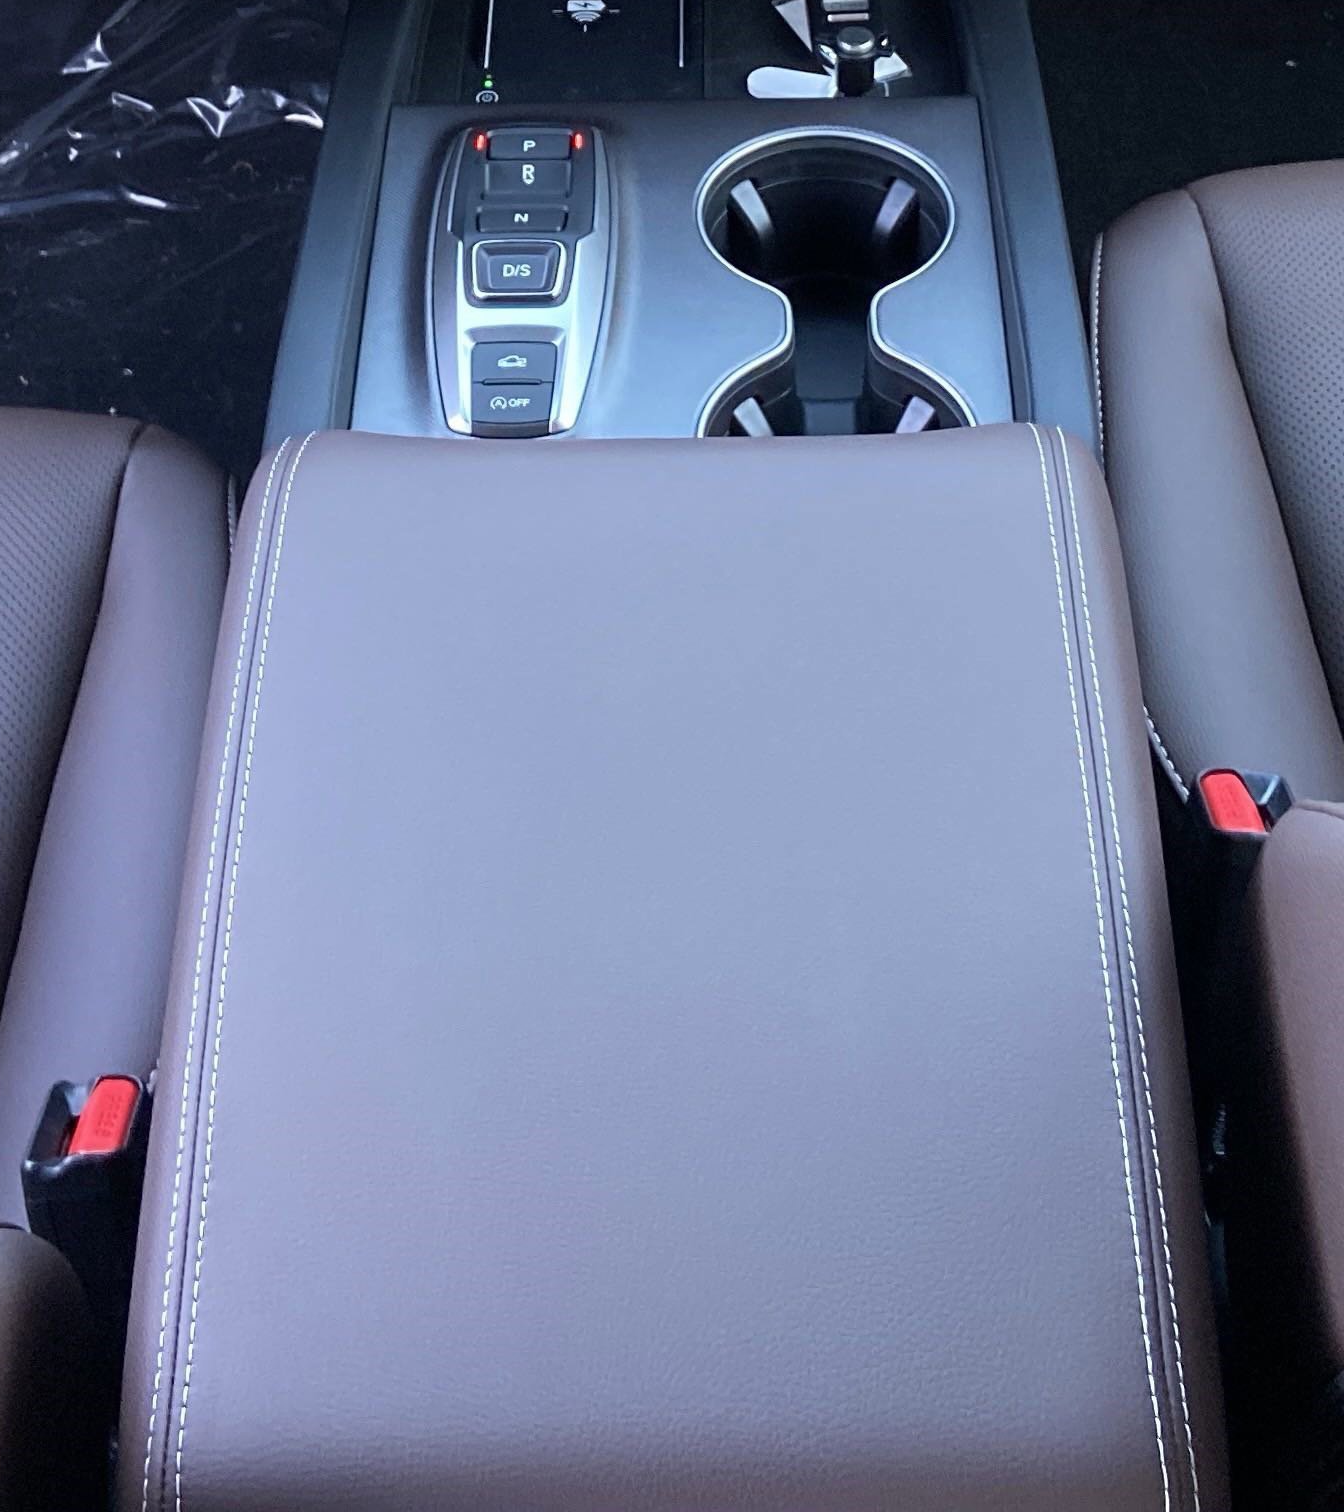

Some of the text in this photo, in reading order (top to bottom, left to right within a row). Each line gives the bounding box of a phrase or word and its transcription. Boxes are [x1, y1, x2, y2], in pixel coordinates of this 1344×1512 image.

[523, 140, 536, 151] P
[522, 164, 535, 180] R
[514, 213, 529, 223] N
[503, 264, 531, 277] D/S
[508, 398, 531, 407] OFF
